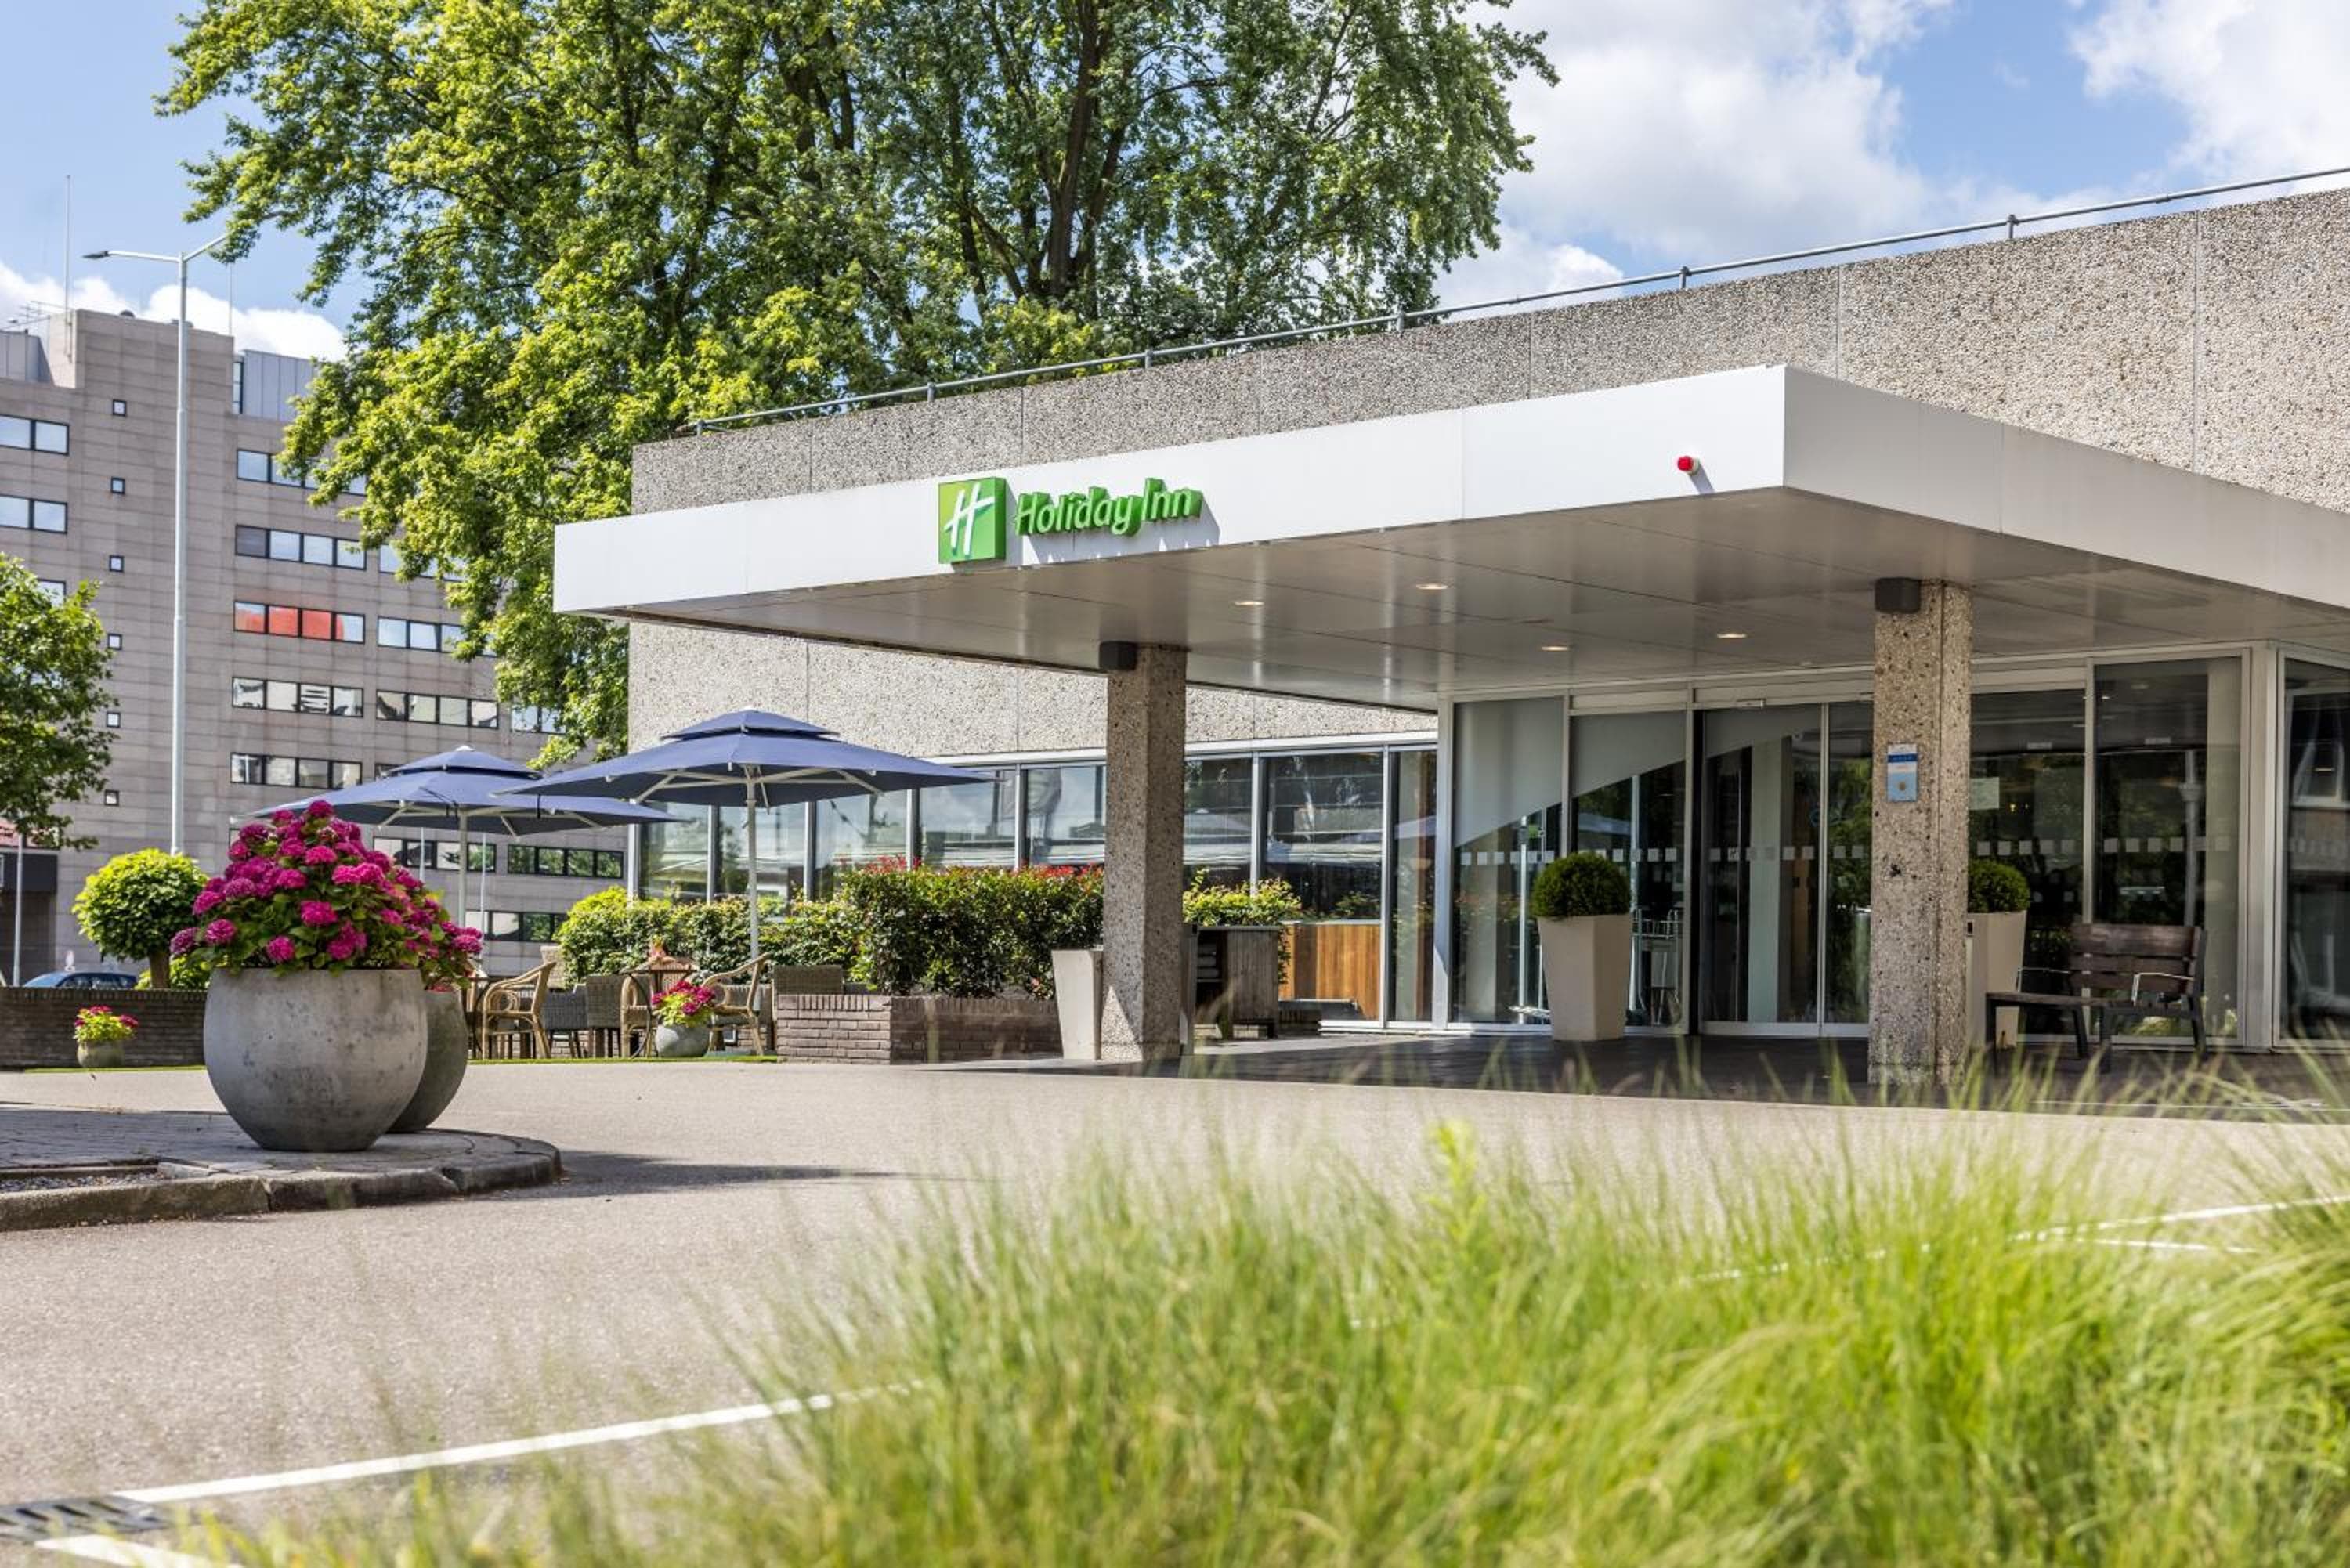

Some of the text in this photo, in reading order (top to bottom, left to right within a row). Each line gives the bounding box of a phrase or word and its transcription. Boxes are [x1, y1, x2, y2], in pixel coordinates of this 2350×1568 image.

[944, 482, 995, 555] H
[1015, 479, 1201, 536] Holiday Inn
